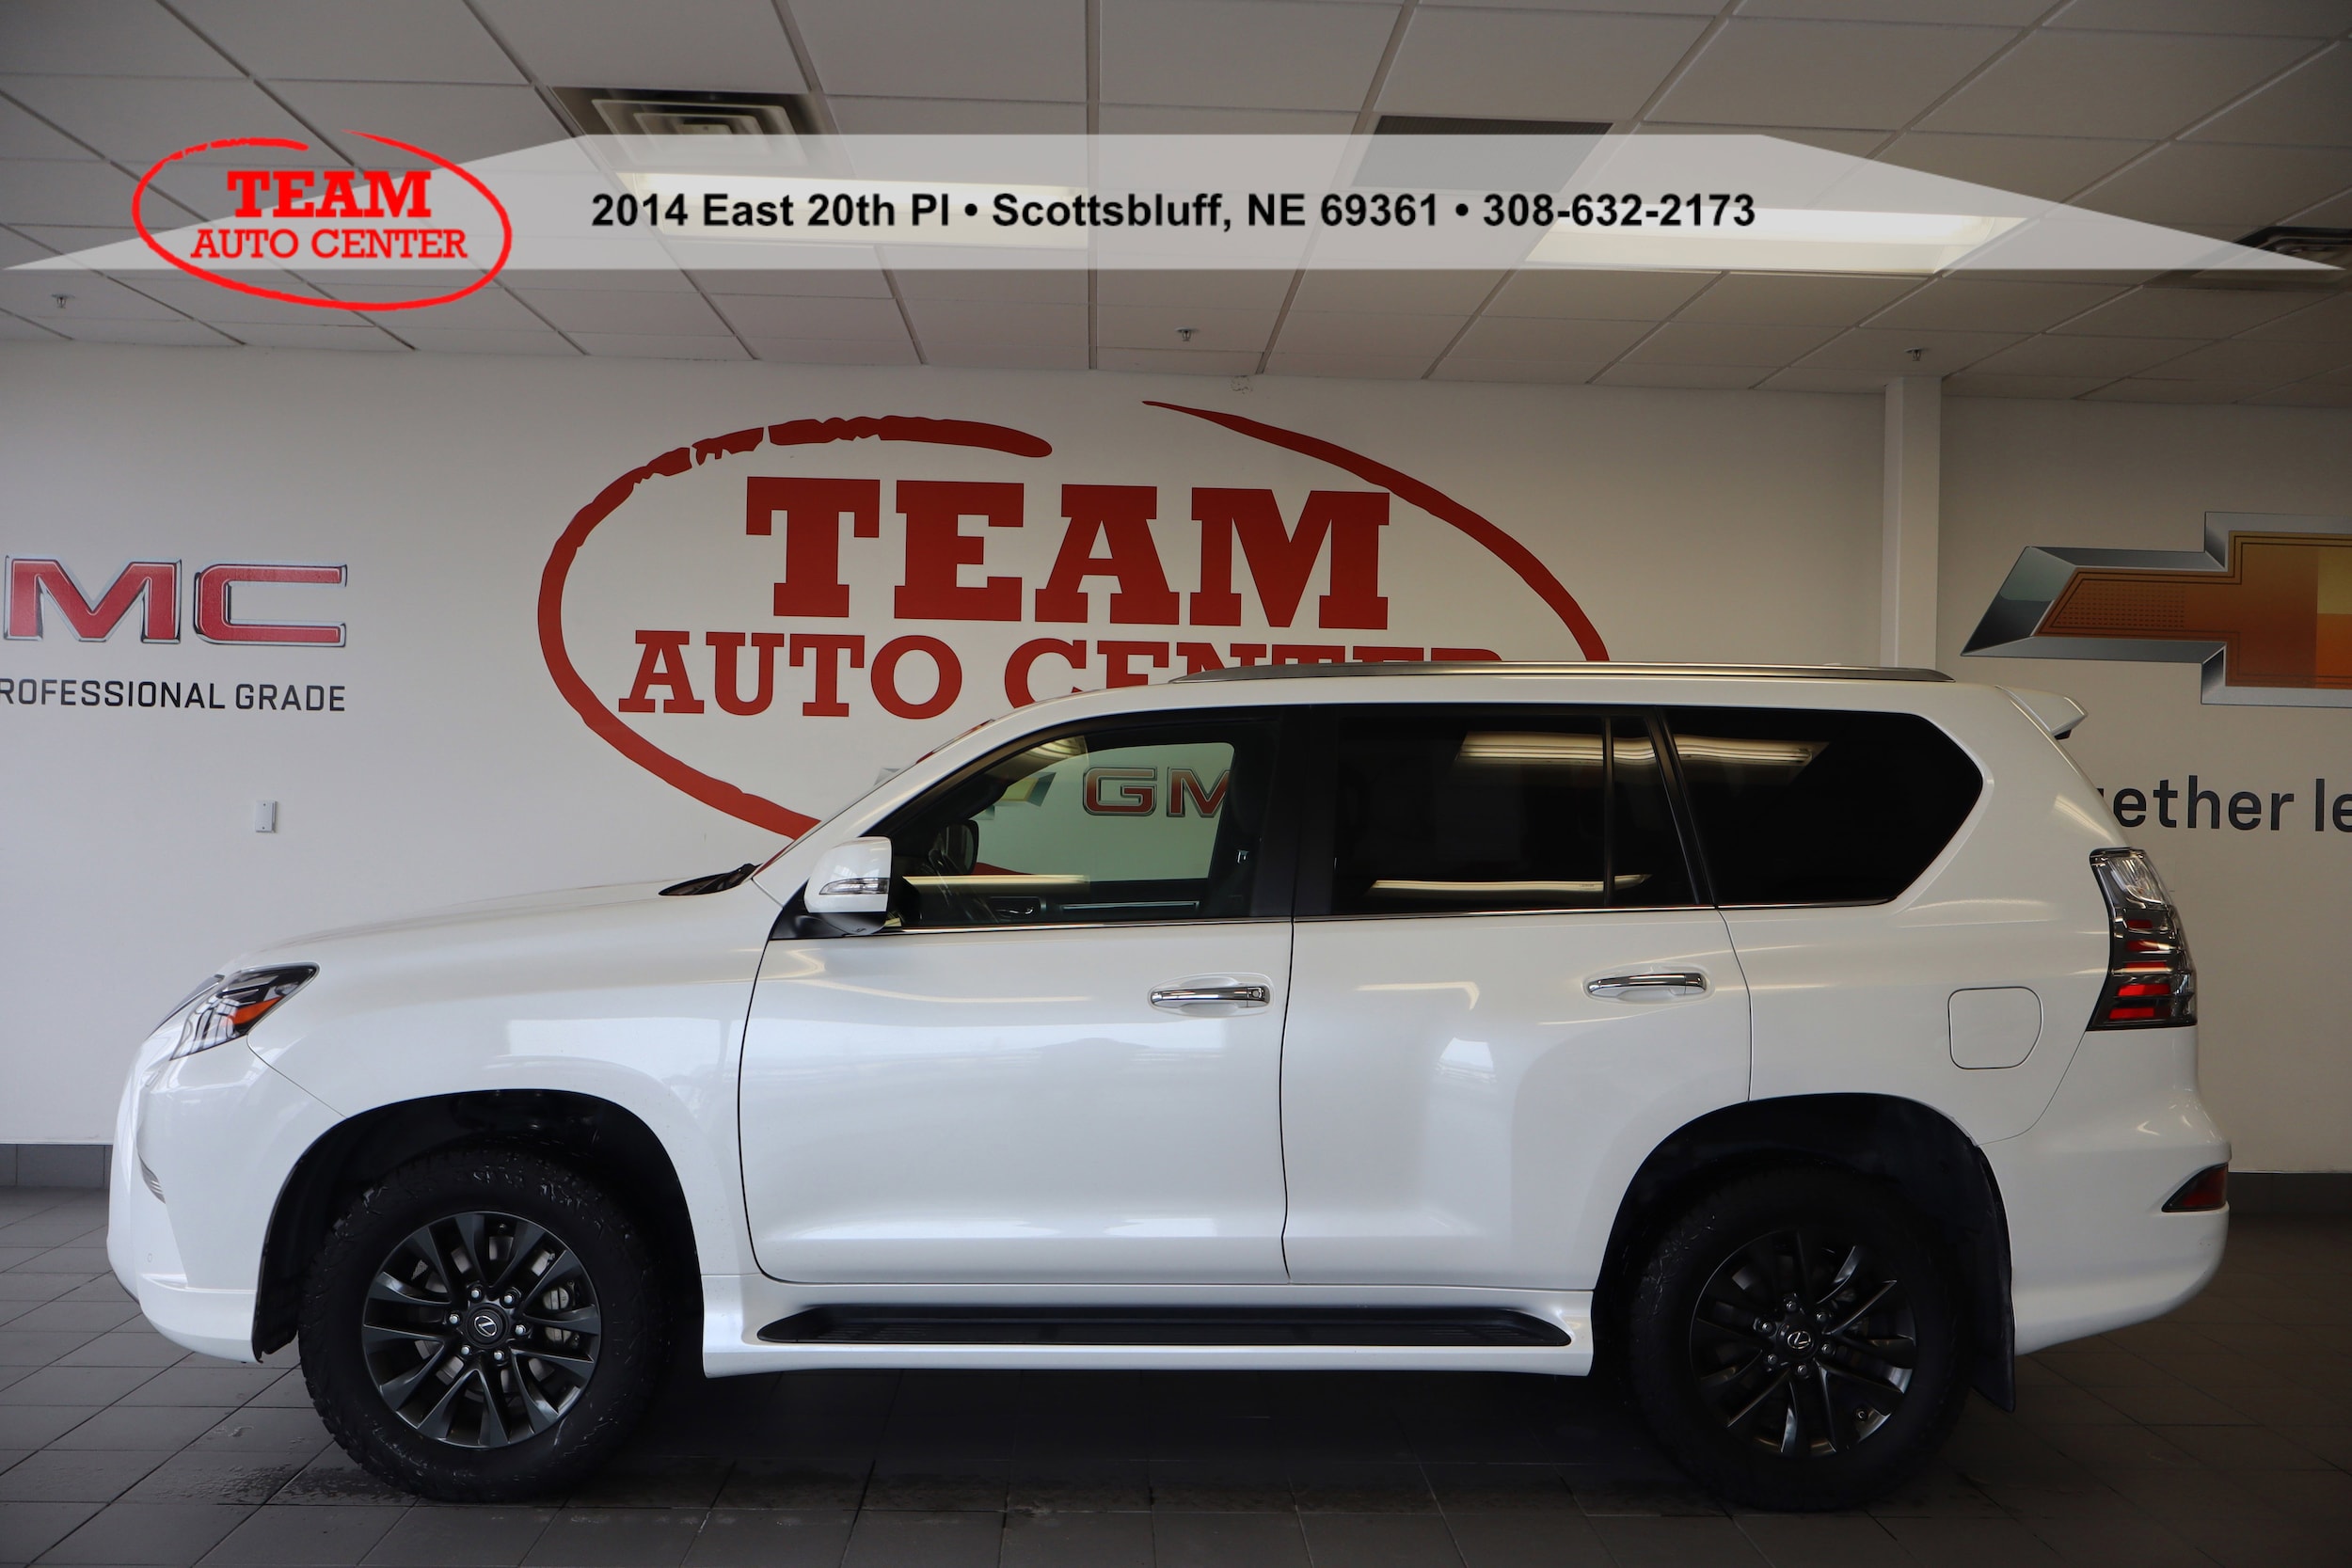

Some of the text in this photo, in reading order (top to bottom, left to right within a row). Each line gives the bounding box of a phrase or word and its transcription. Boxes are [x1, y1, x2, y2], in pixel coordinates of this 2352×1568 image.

[745, 476, 1391, 630] TEAM
[235, 683, 346, 712] GRADE
[617, 629, 963, 720] AUTO
[2096, 774, 2295, 832] ether
